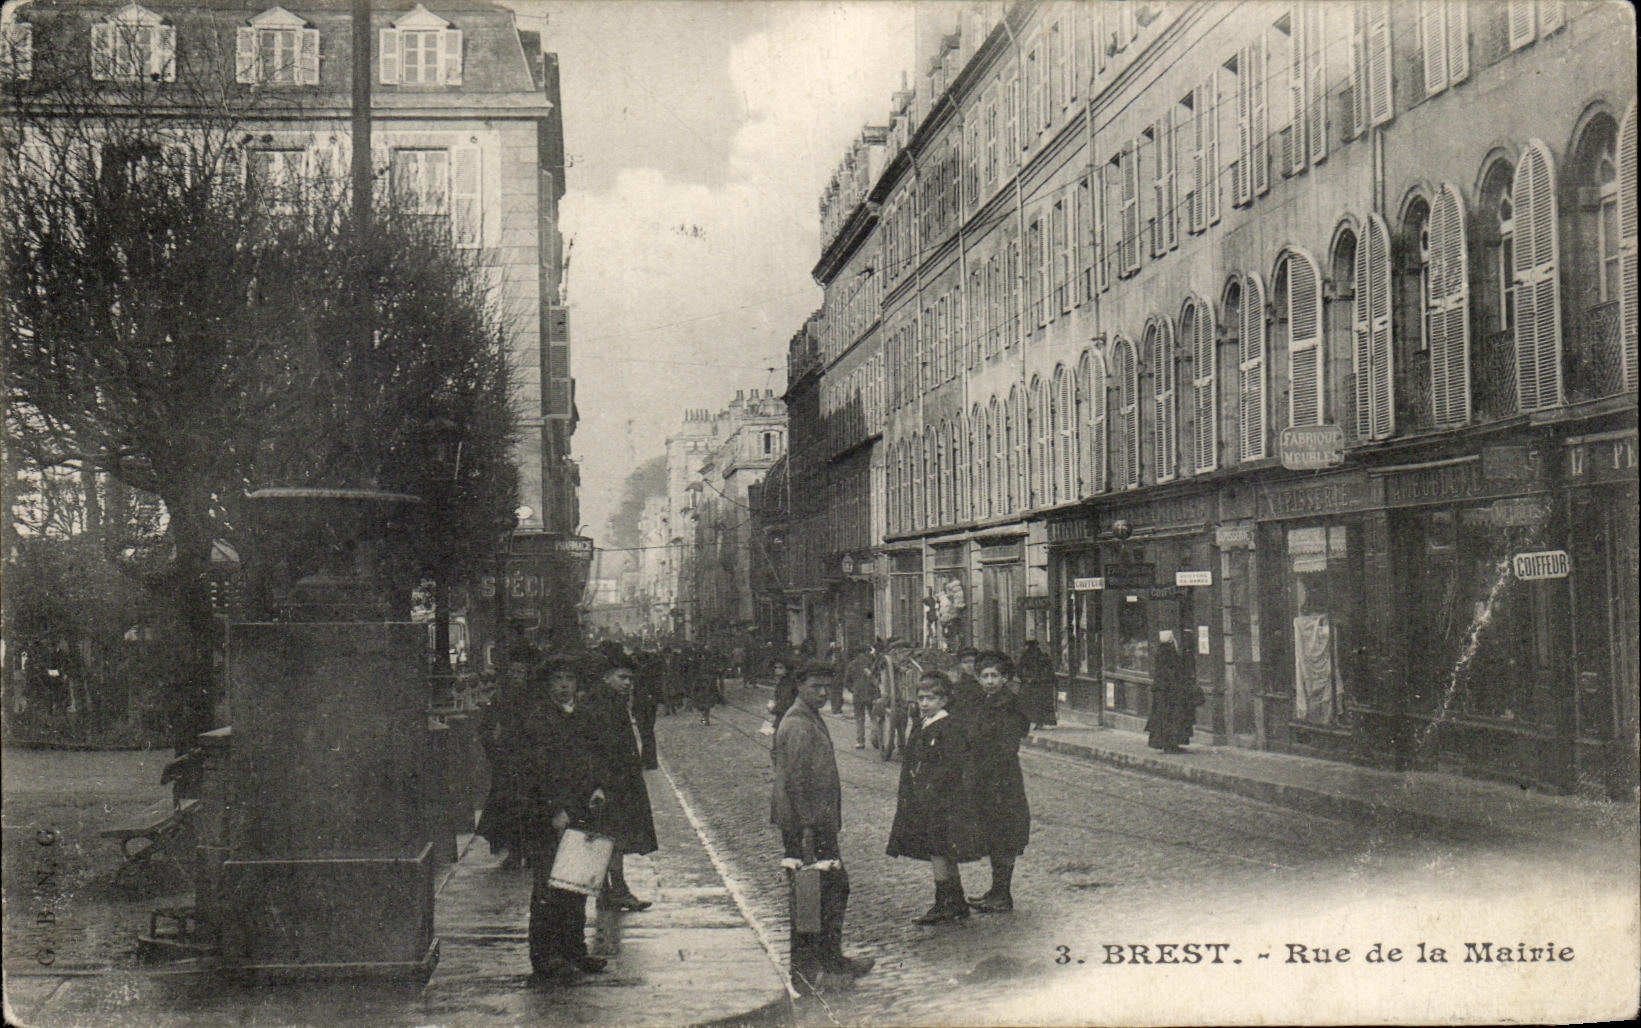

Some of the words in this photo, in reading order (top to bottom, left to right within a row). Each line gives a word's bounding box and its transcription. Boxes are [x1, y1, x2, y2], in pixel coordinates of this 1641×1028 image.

[1282, 431, 1341, 448] FABRIQUE
[1284, 449, 1339, 466] MEUBLES
[1517, 552, 1568, 577] COIFFEUR
